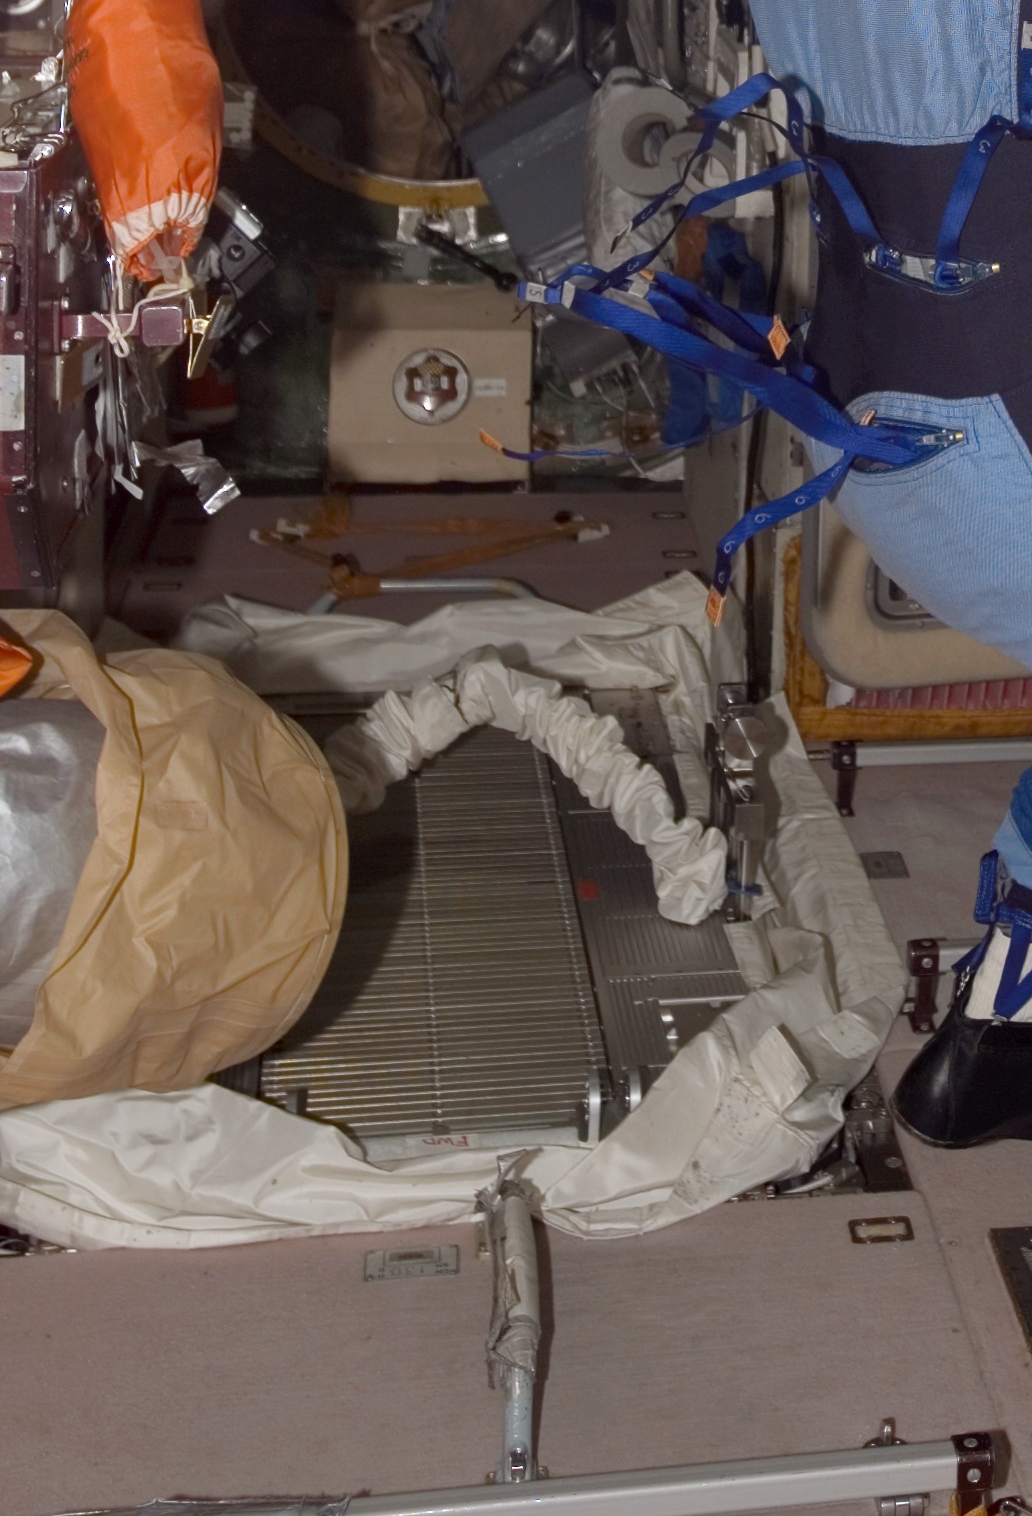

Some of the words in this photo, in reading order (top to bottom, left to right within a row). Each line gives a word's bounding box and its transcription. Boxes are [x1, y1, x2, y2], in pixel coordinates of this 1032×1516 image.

[754, 512, 771, 524] 6
[723, 540, 735, 555] 6
[422, 1135, 470, 1148] FWD
